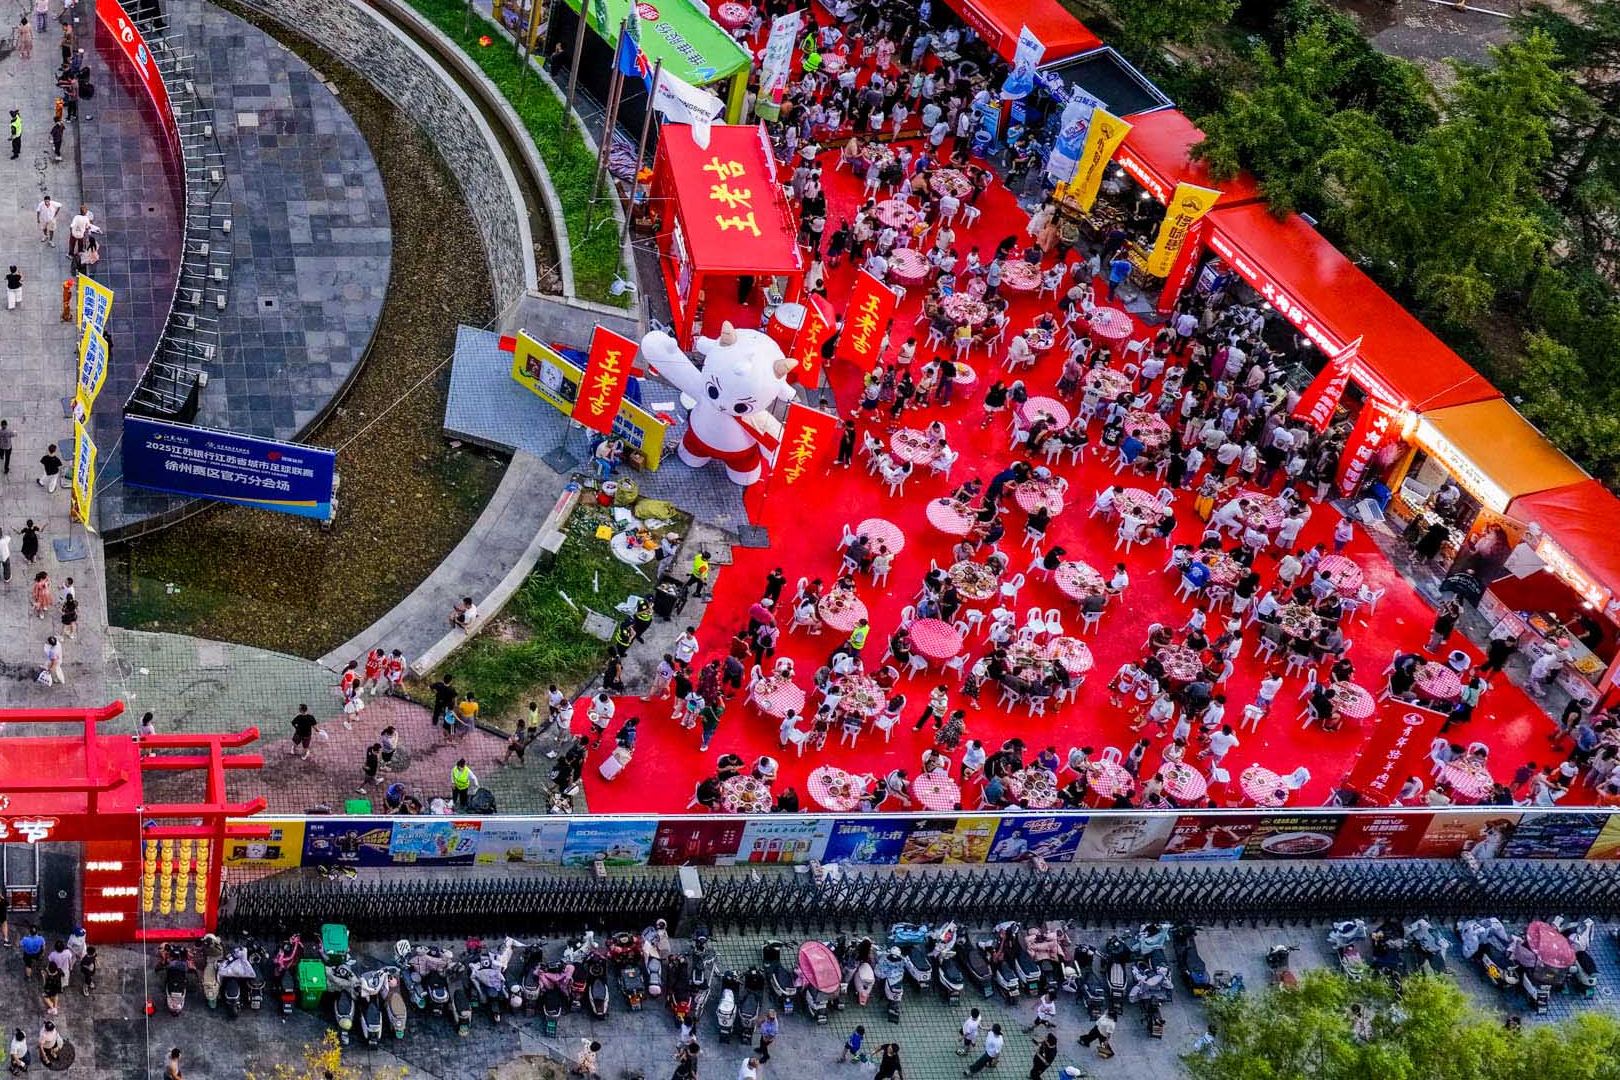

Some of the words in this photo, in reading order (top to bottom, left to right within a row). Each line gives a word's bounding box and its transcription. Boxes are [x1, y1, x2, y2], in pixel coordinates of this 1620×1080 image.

[655, 20, 708, 67] 维维股份
[703, 156, 763, 238] 王老吉
[854, 292, 881, 355] 王老吉
[588, 349, 623, 417] 王老吉
[145, 441, 314, 478] 2025江苏银行江苏省城市足球联赛
[164, 460, 290, 491] 徐州赛区官方分会场
[783, 425, 817, 485] 王老吉
